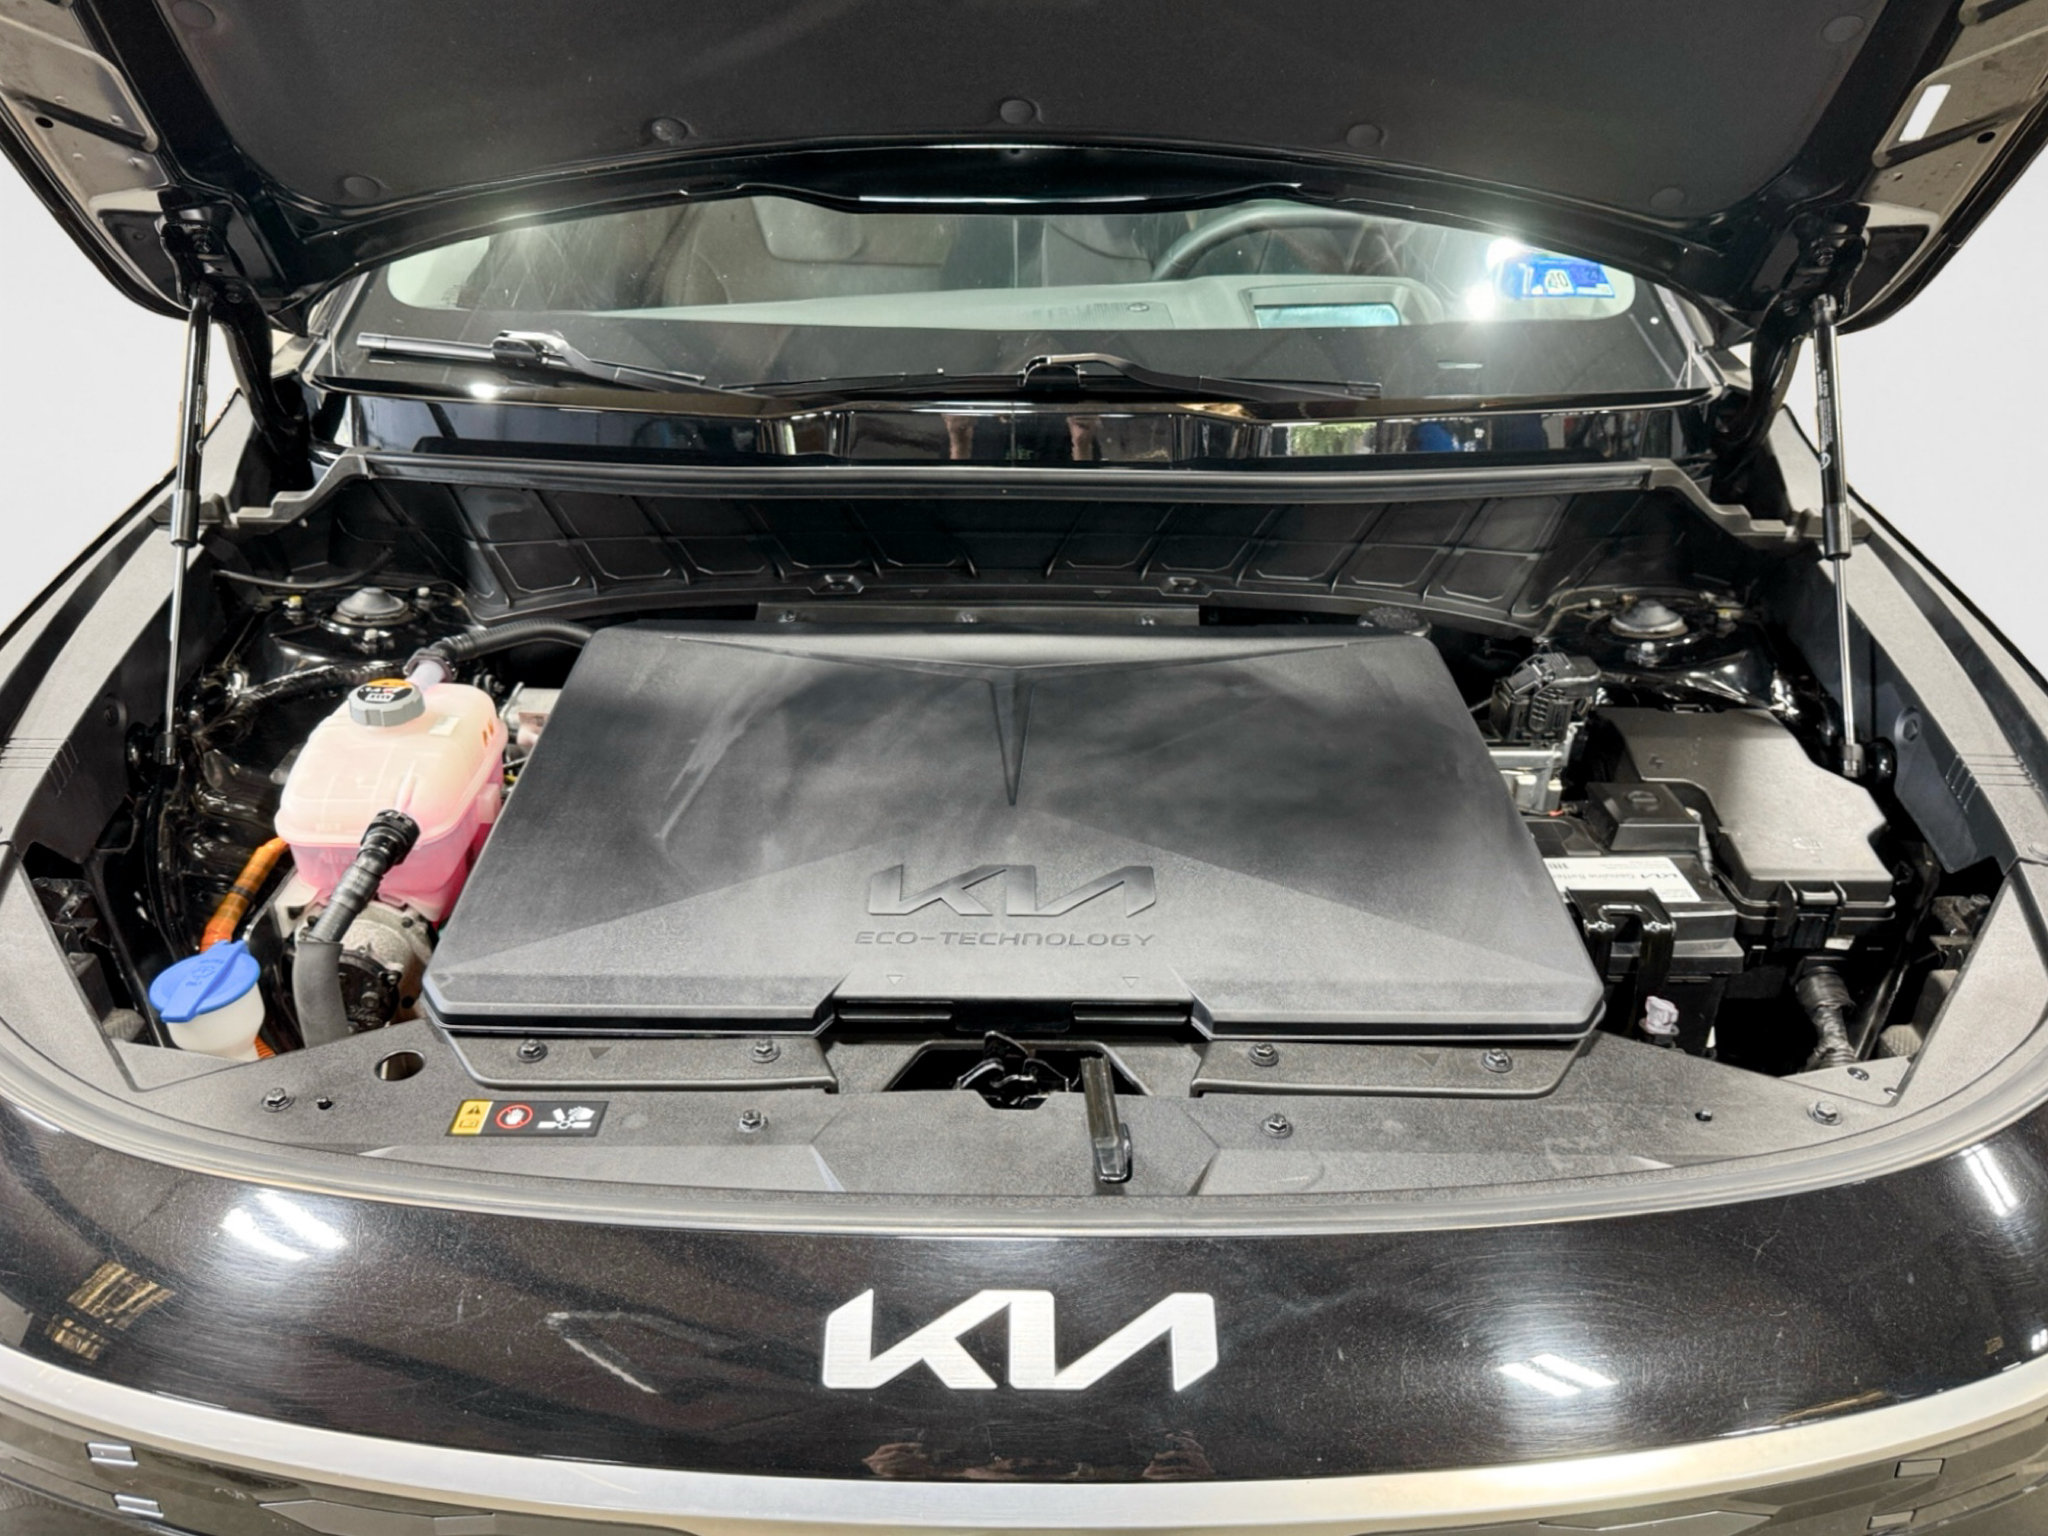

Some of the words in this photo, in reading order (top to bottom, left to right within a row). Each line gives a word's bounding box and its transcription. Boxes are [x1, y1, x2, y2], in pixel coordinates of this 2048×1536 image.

[868, 864, 1157, 918] KIA
[854, 930, 1156, 947] ECO-TECHNOLOGY
[822, 1288, 1218, 1392] KIA
